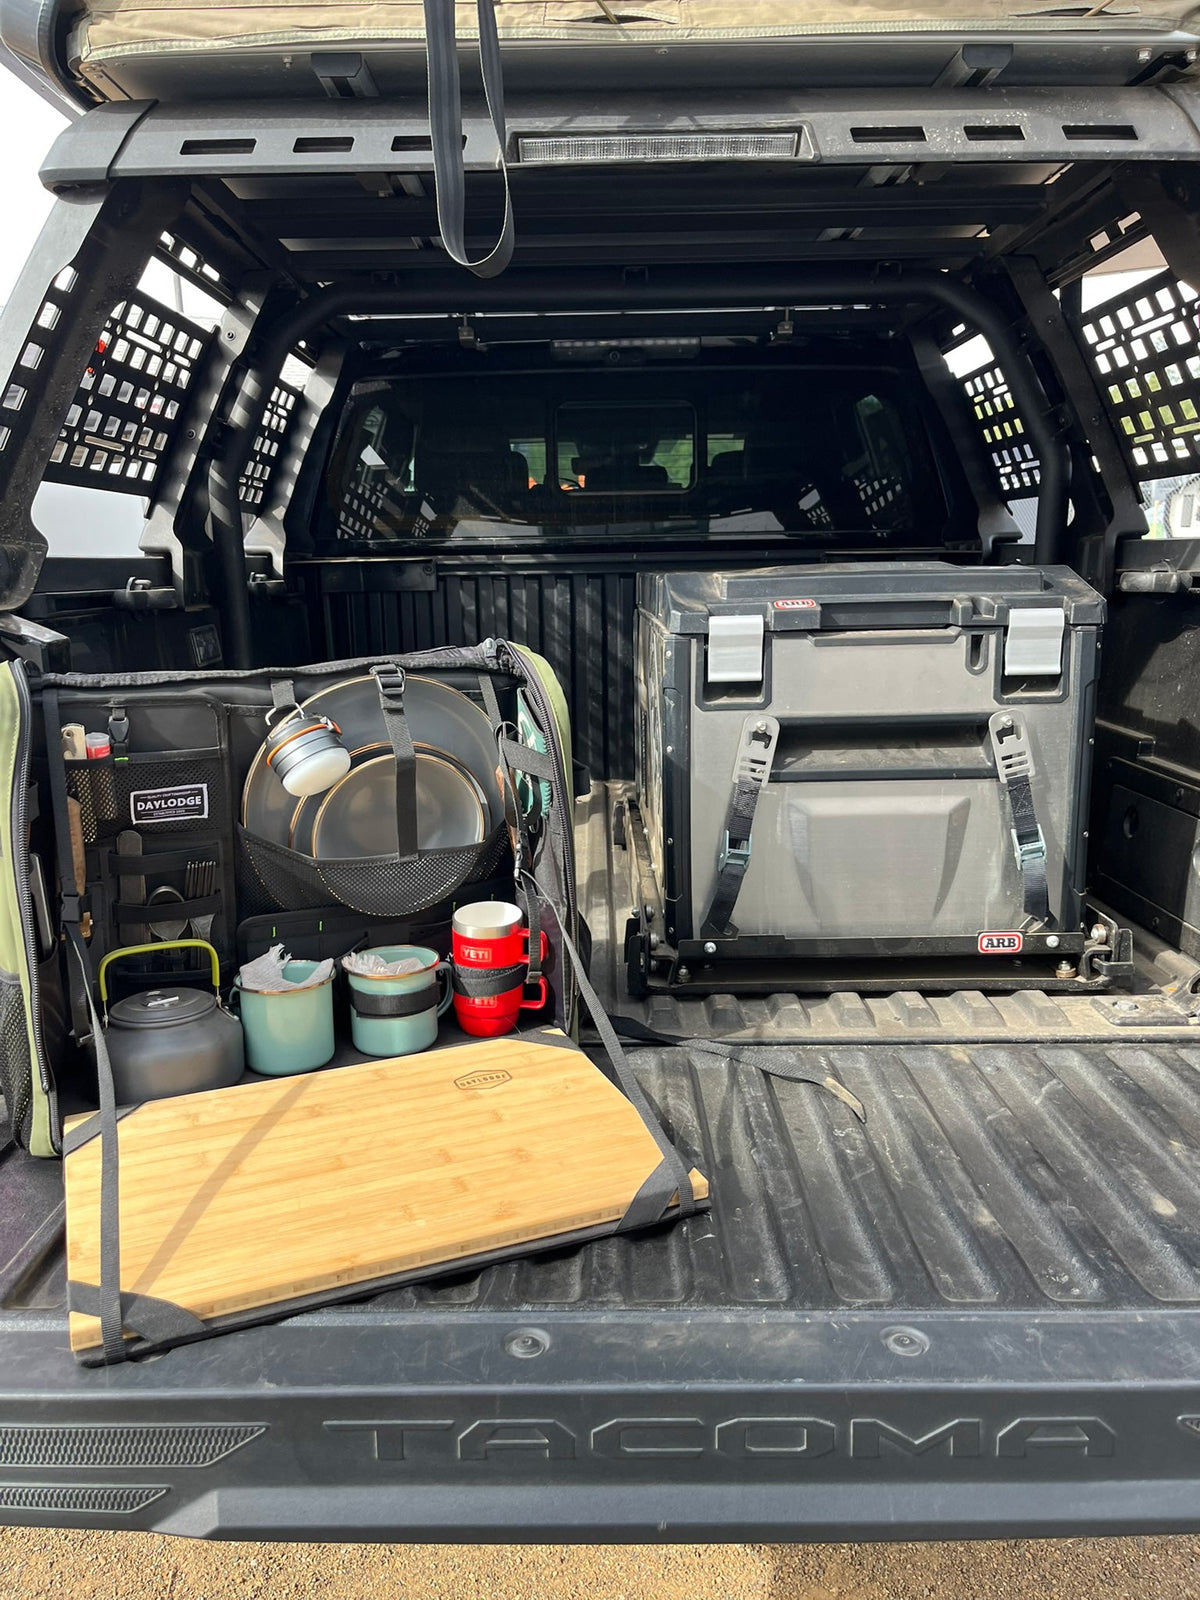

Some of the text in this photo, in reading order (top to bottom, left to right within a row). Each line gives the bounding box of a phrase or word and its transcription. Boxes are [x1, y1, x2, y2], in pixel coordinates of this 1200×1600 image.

[137, 795, 202, 811] DAYLODGE
[985, 937, 1017, 949] ARB
[463, 948, 489, 959] YETI
[321, 1416, 1117, 1461] TACOMA
